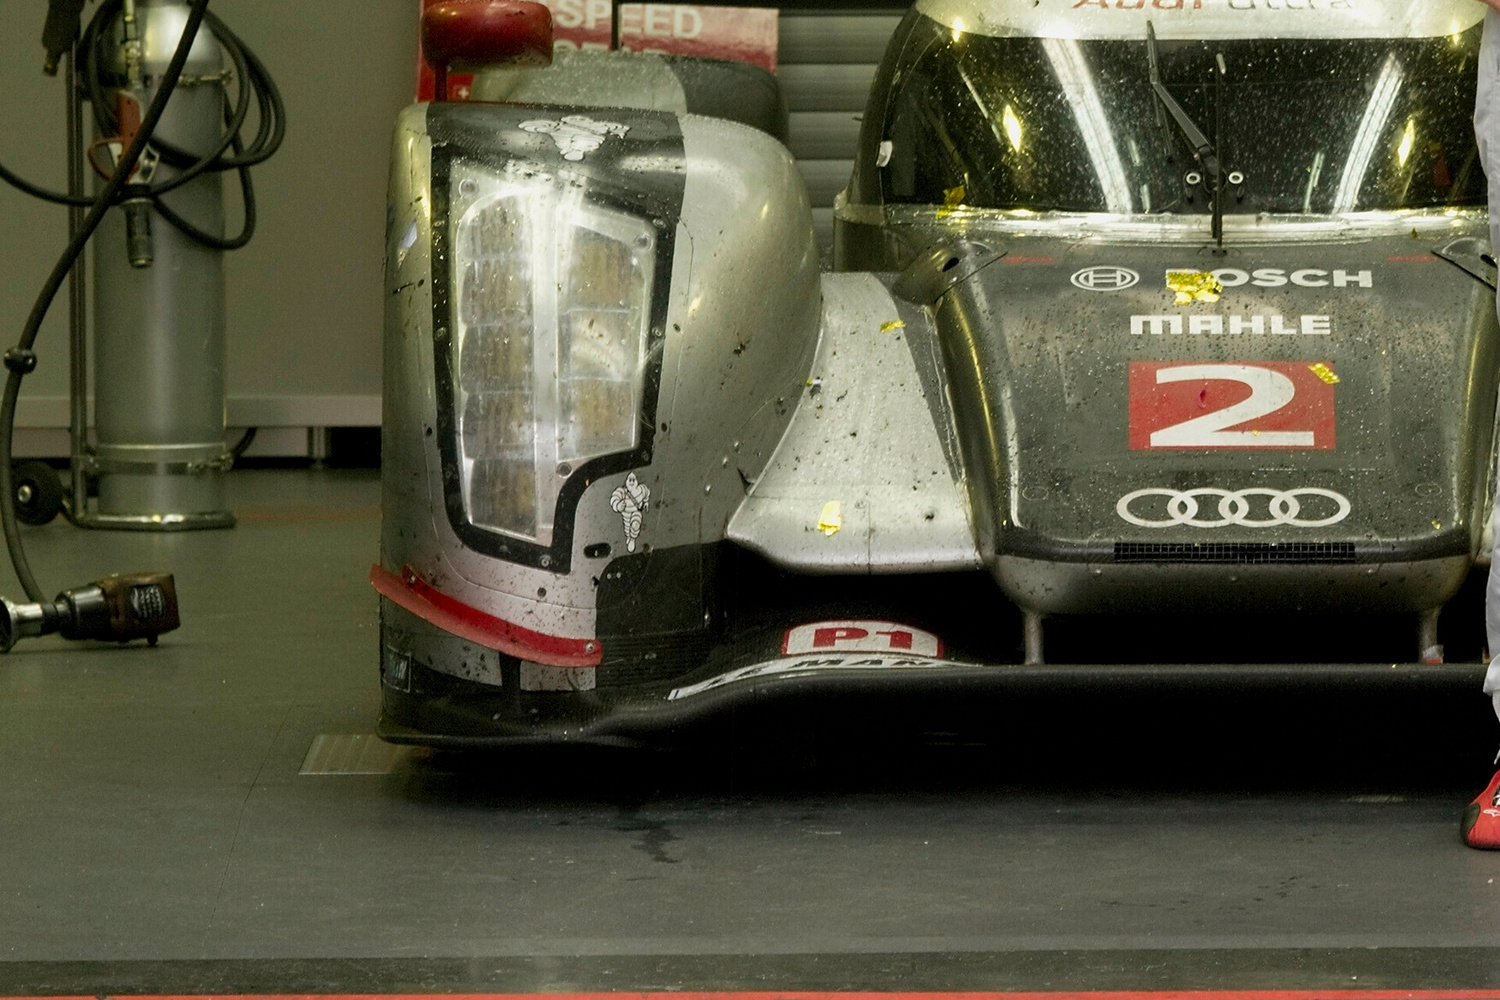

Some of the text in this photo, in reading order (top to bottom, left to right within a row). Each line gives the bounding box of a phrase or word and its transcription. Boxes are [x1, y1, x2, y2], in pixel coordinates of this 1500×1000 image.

[1166, 268, 1373, 289] OSCH
[1130, 314, 1331, 335] MAHLE
[1150, 363, 1314, 447] 2
[813, 626, 912, 650] P1
